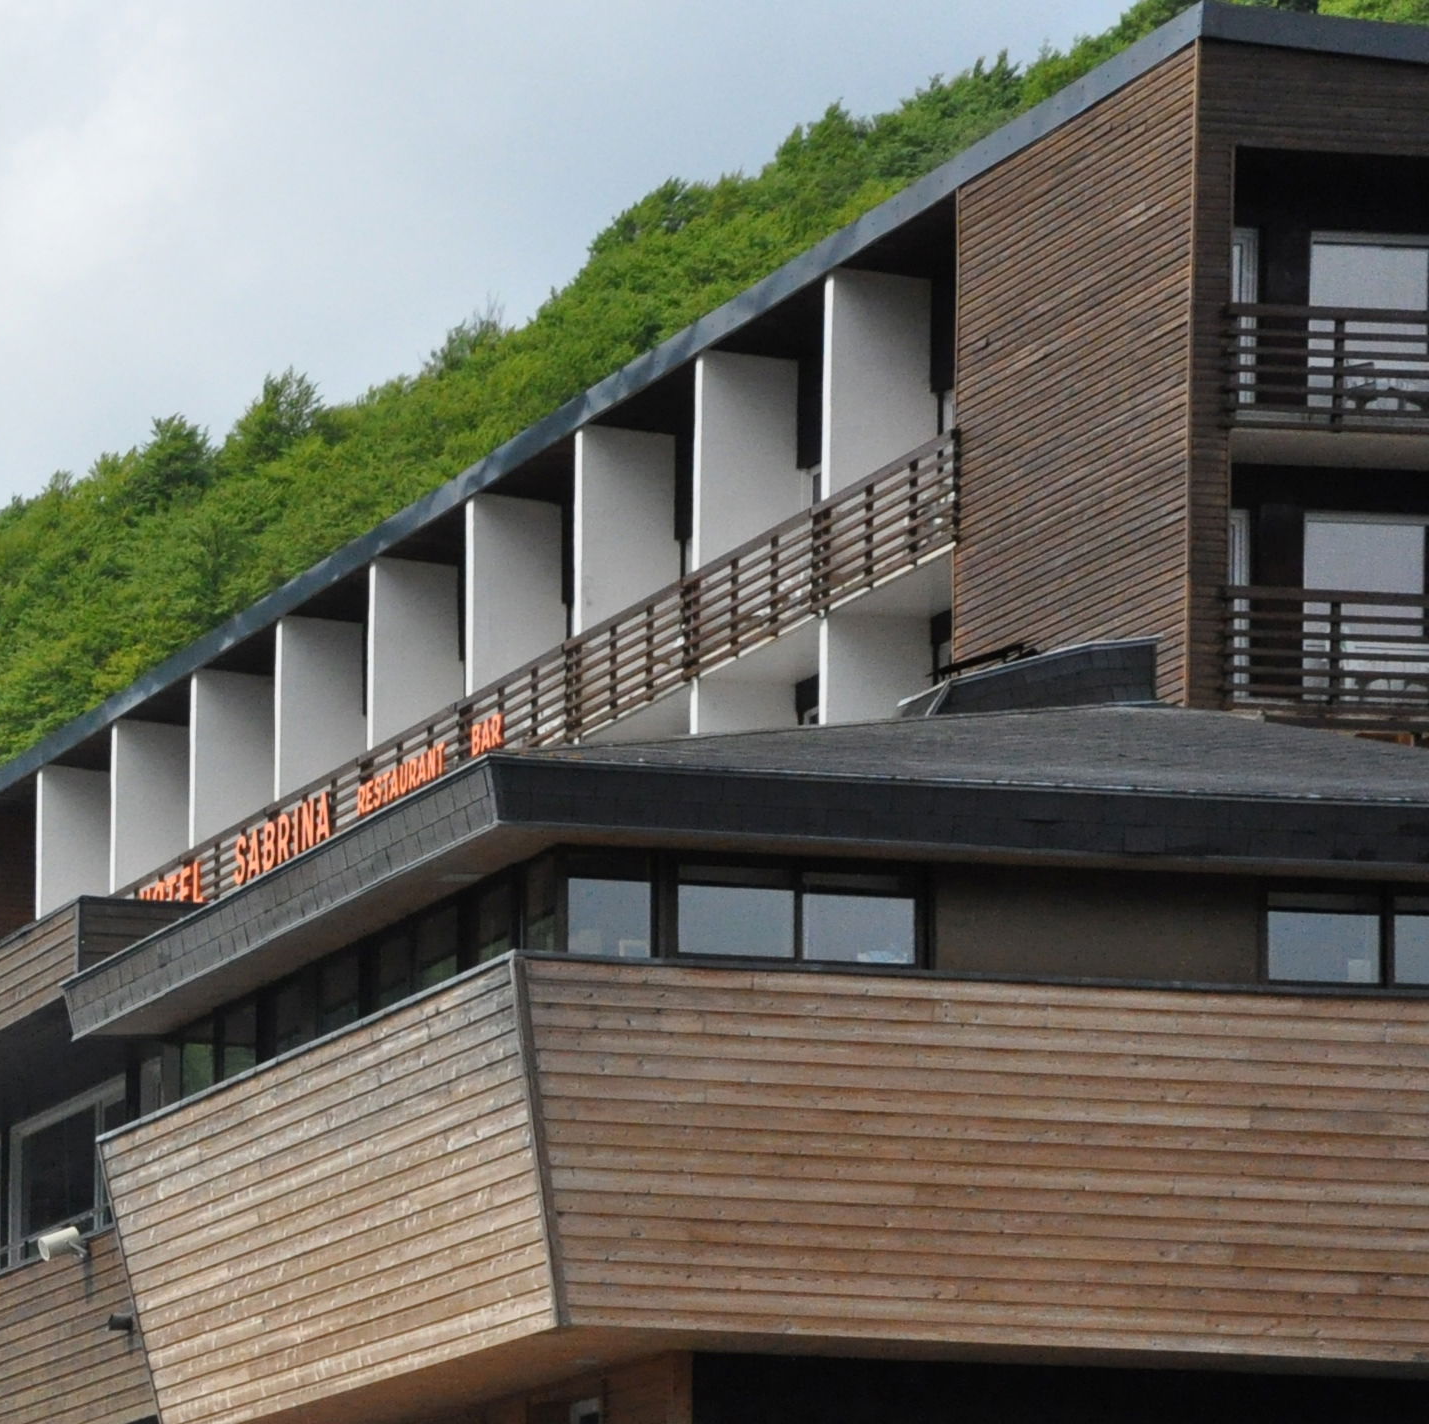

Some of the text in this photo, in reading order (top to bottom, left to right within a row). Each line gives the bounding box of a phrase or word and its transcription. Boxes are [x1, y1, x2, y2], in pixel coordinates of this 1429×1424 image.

[233, 791, 331, 885] SABRINA
[356, 742, 448, 817] RESTAURANT
[470, 713, 504, 758] BAR
